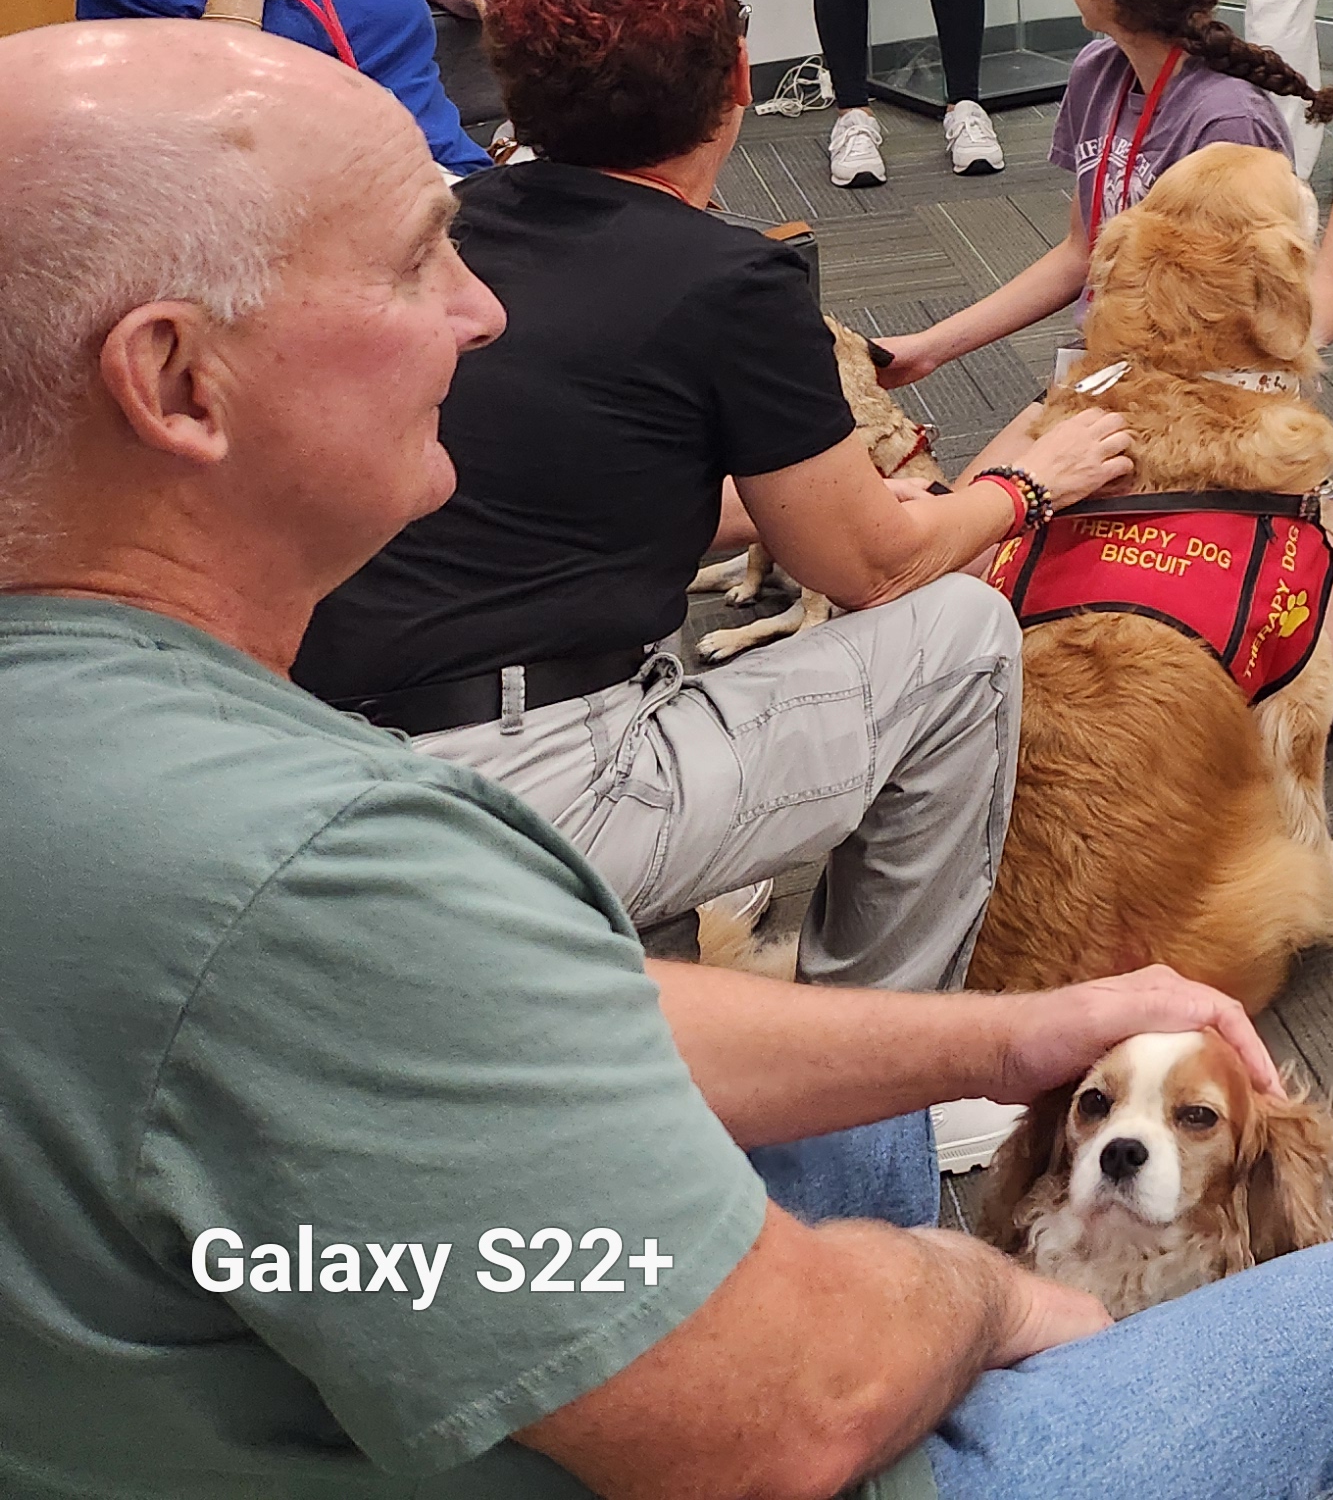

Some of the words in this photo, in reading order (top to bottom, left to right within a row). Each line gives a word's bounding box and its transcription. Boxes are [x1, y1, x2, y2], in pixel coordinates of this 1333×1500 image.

[1070, 517, 1178, 549] THERAPY
[1186, 540, 1233, 571] DOG
[1100, 543, 1193, 578] BISCUIT
[1281, 525, 1301, 573] DOG
[1244, 578, 1291, 678] THERAPY
